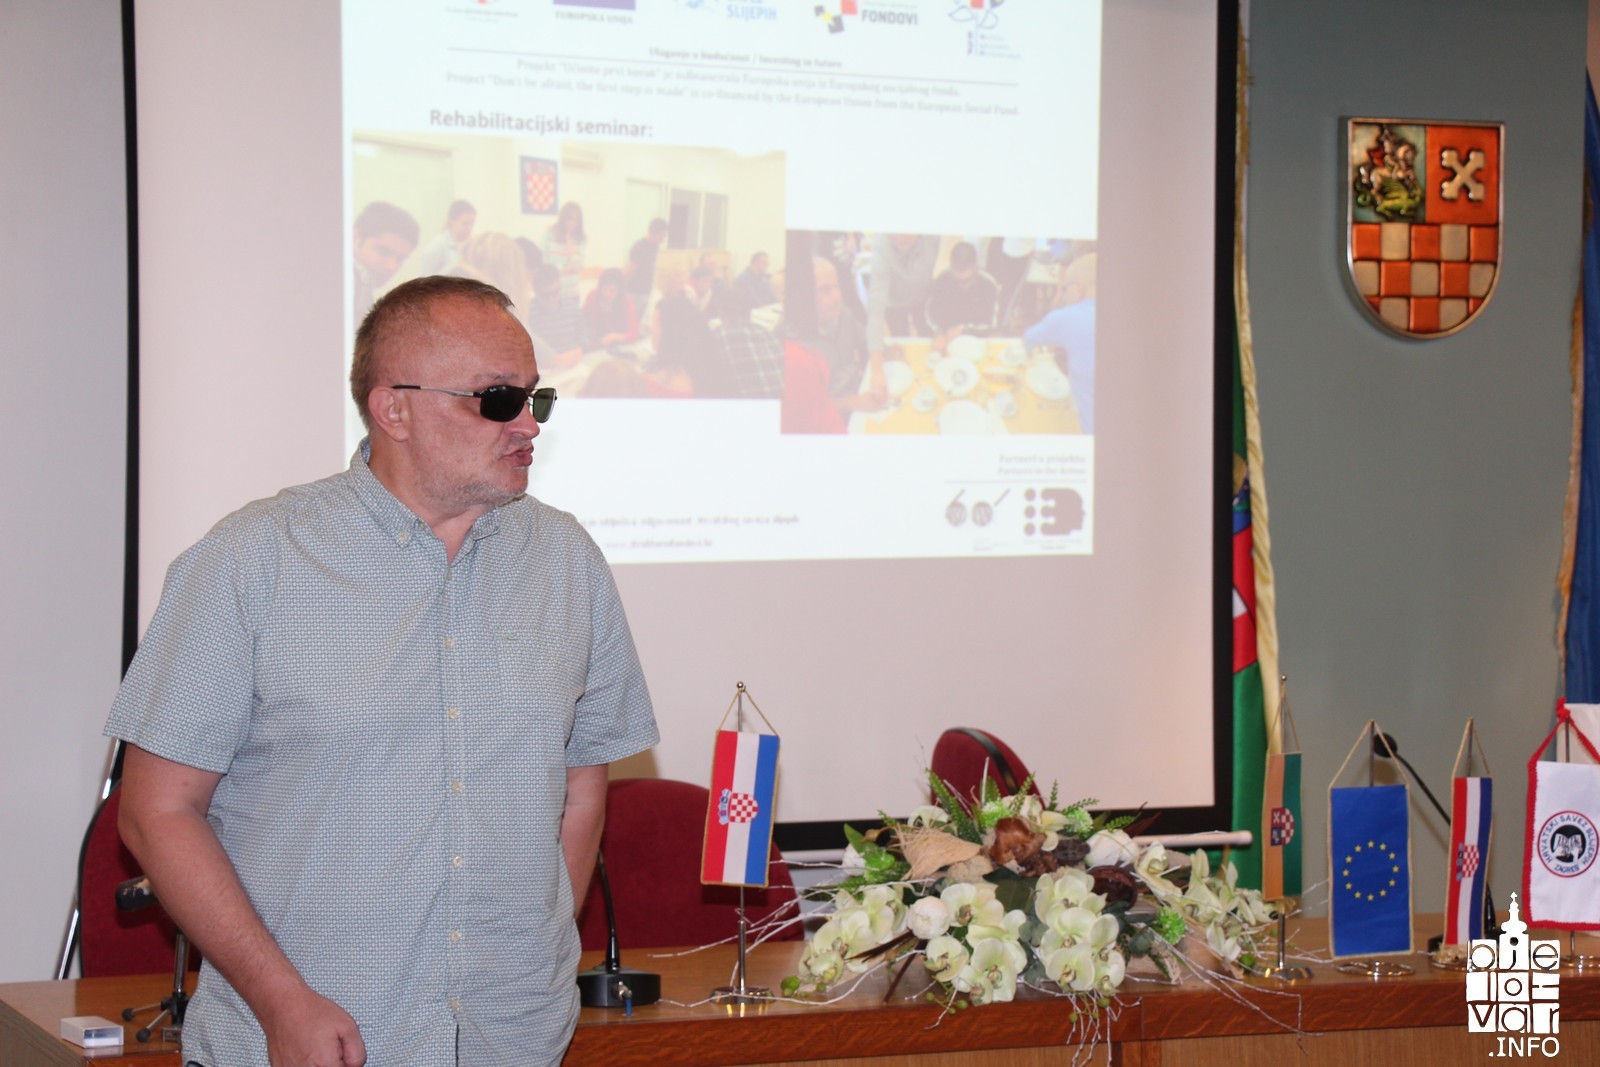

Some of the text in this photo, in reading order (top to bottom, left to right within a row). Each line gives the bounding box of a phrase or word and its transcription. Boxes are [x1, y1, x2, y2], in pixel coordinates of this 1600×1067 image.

[555, 10, 633, 25] EUROPSKA UNIJA
[726, 5, 777, 21] SLIJEPIH
[861, 9, 918, 26] FONDOVI
[516, 59, 556, 74] Projekt
[446, 72, 485, 87] Project
[524, 76, 538, 88] be
[576, 79, 594, 91] the
[596, 81, 618, 93] first
[620, 83, 641, 97] step
[644, 85, 653, 95] is
[690, 87, 700, 98] is
[761, 91, 773, 105] by
[776, 91, 792, 103] the
[794, 93, 841, 108] European
[875, 97, 898, 110] from
[900, 99, 915, 111] the
[917, 100, 963, 115] European
[429, 109, 653, 138] Rehabilitacijski seminar:
[1541, 819, 1559, 864] HRVATSKI
[1560, 814, 1588, 828] SAVEZ
